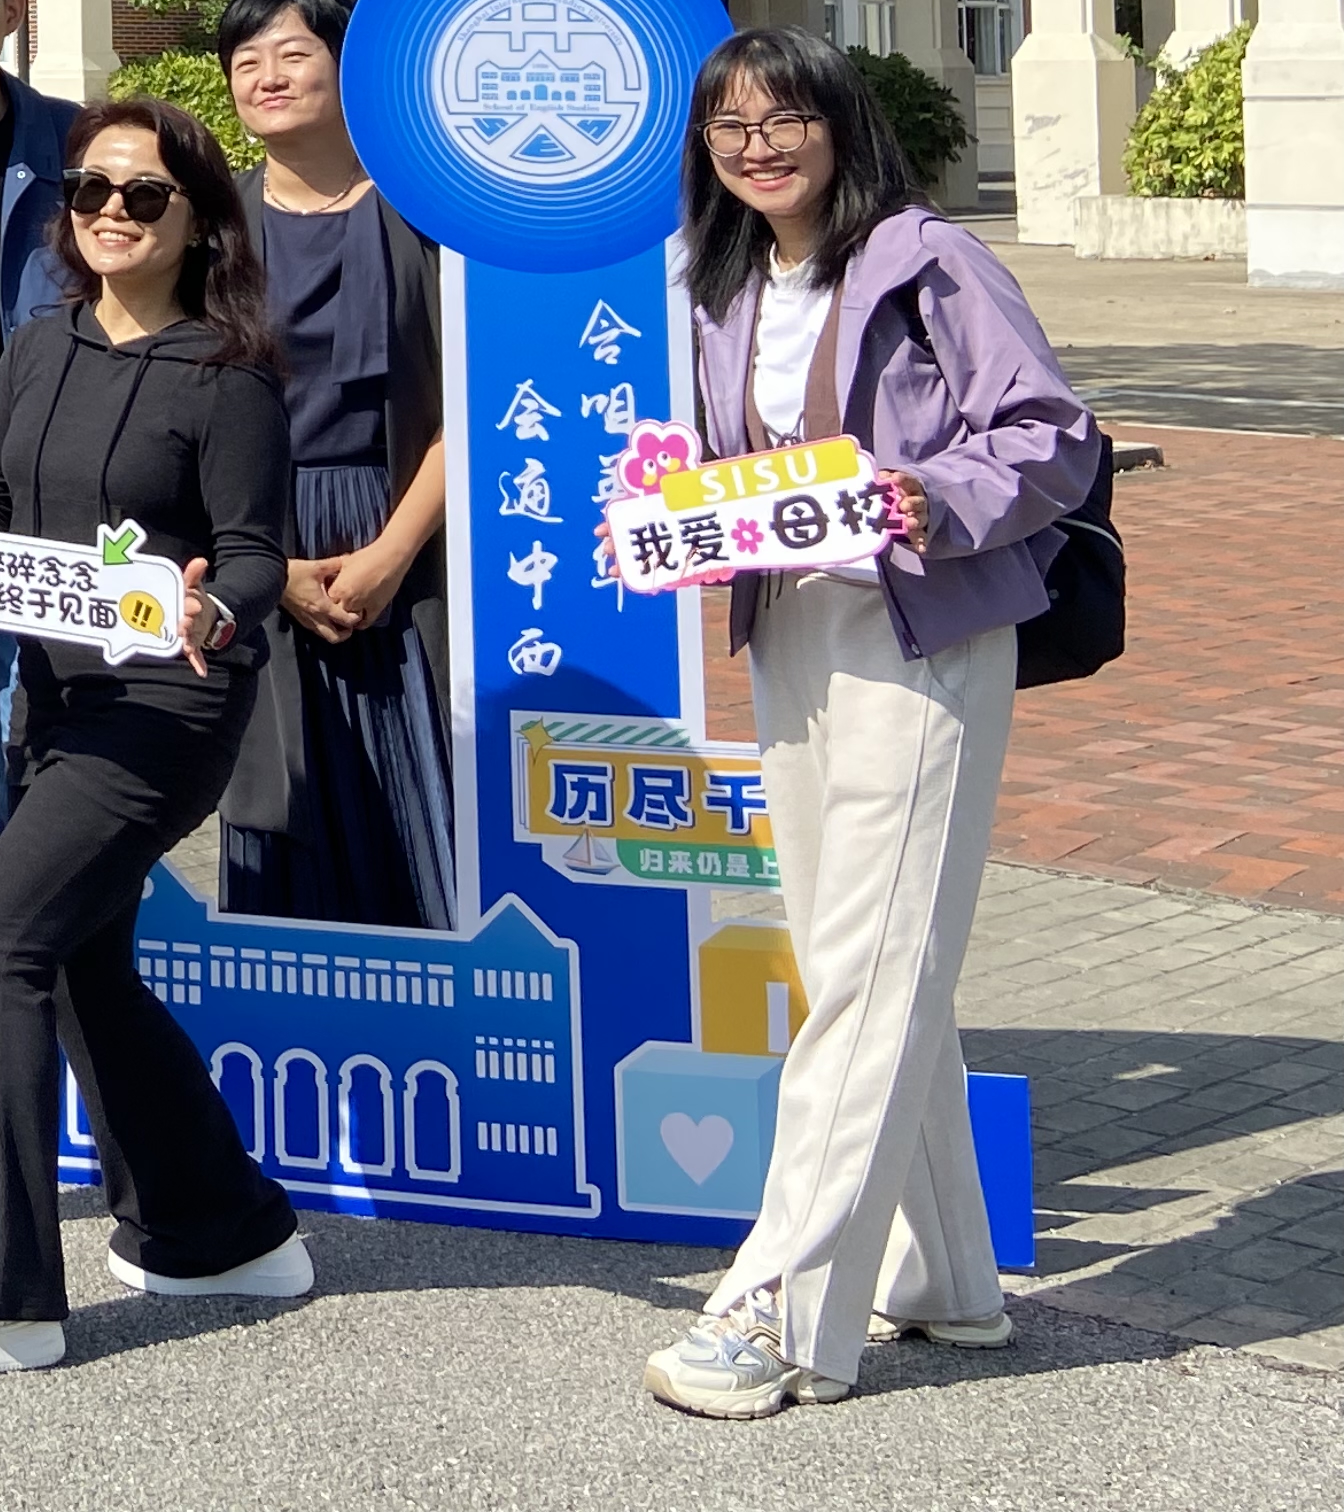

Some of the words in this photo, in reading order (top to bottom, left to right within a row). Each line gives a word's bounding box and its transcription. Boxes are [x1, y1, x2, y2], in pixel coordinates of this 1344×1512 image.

[699, 449, 819, 503] SISU
[629, 510, 730, 576] 我爱
[769, 480, 905, 550] 母校
